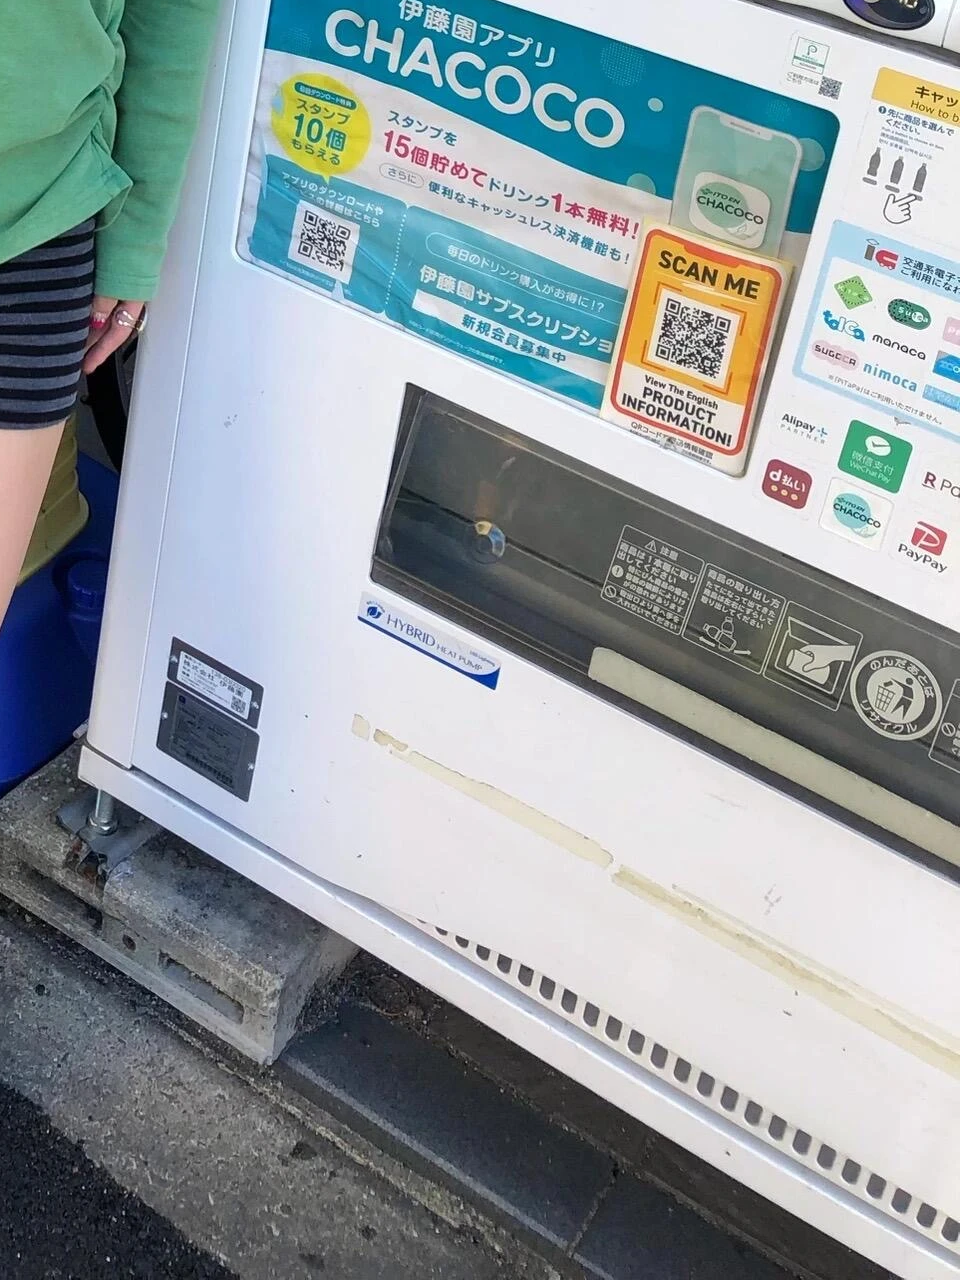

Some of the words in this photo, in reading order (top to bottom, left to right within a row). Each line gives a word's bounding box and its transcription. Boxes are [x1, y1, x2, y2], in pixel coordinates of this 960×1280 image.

[325, 8, 625, 149] CHACOCO
[297, 99, 351, 125] スタンプ
[911, 100, 934, 114] How
[938, 109, 949, 119] to
[294, 113, 346, 152] 10個
[388, 110, 457, 147] スタンプを
[292, 139, 340, 165] もらえる
[281, 171, 384, 216] アプリのダウンロードや
[388, 169, 417, 185] さらに
[697, 195, 764, 226] CHACOCO
[658, 249, 718, 287] SCAN
[724, 273, 761, 300] ME
[462, 313, 567, 363] 新規会員募集中
[872, 334, 926, 361] manaca
[644, 374, 667, 391] View
[669, 383, 685, 396] The
[687, 389, 719, 410] English
[864, 363, 918, 392] nimoca
[621, 393, 733, 447] INFORMATION!
[642, 386, 716, 424] PRODUCT
[769, 469, 806, 493] d払い
[849, 460, 877, 480] WeChat
[878, 472, 890, 484] Pay
[833, 502, 881, 529] CHACOCO
[617, 550, 677, 584] 出してください
[898, 543, 948, 574] PayPay
[705, 581, 776, 618] たてになって出てきた
[708, 569, 781, 609] 商品の取り出し方
[701, 596, 764, 630] 取り出してください
[387, 614, 436, 647] HYBRID
[437, 643, 457, 659] HEAT
[459, 655, 482, 671] PUMP
[870, 657, 934, 699] のんだあとは
[860, 699, 918, 733] リサイクル
